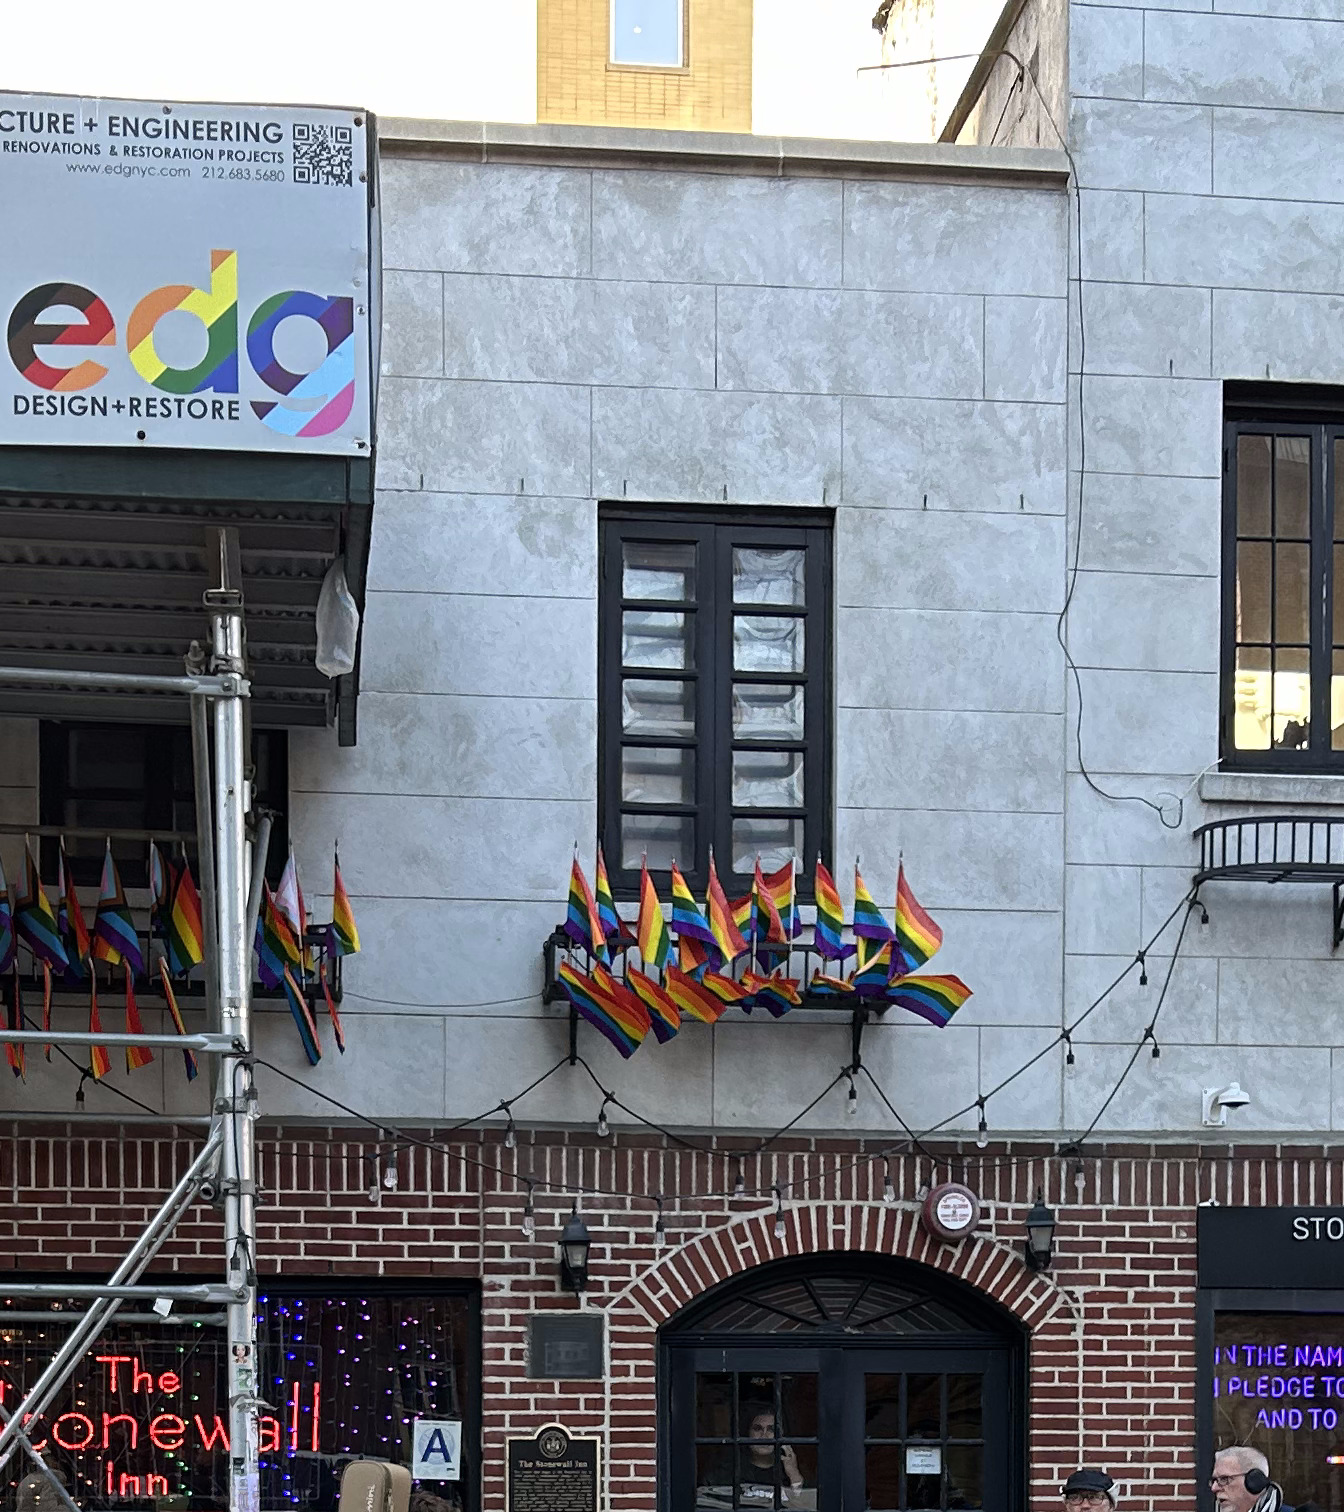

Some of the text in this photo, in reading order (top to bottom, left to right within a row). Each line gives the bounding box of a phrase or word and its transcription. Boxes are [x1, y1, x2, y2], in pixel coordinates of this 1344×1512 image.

[83, 117, 98, 133] +
[108, 115, 284, 144] ENGINEERING
[3, 140, 101, 156] RENOVATIONS
[109, 145, 118, 157] &
[123, 145, 214, 162] RESTORATION
[219, 149, 285, 164] PROJECTS
[66, 162, 285, 182] www.edgnyc.com 212.683.5680
[7, 249, 355, 437] edg
[13, 394, 240, 421] DESIGN+RESTORE
[1215, 1345, 1237, 1366] IN
[1241, 1345, 1288, 1367] THE
[96, 1355, 181, 1393] The
[1212, 1376, 1220, 1398] I
[1228, 1376, 1315, 1398] PLEDGE
[1256, 1408, 1302, 1430] AND
[1307, 1408, 1337, 1430] TO
[421, 1428, 452, 1463] A
[107, 1460, 168, 1497] Inn
